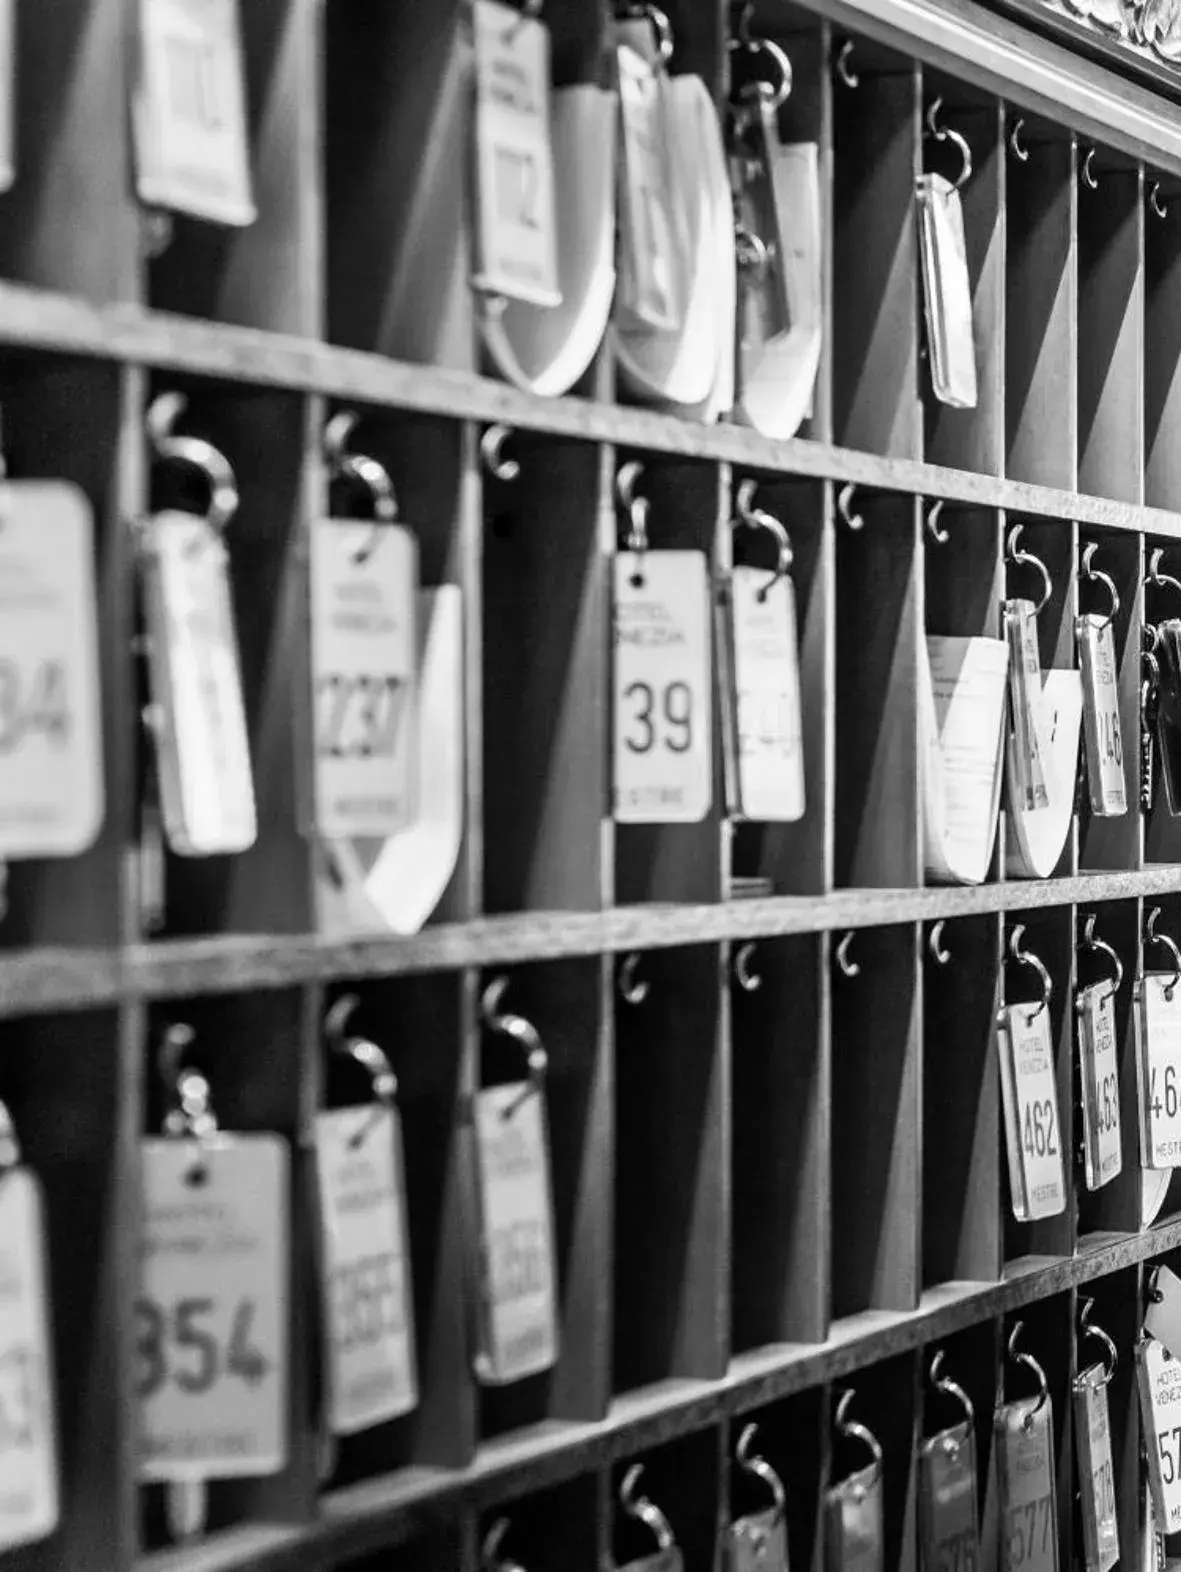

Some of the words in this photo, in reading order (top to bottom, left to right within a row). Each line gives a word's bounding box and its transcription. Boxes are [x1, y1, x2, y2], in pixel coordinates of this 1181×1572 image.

[1024, 1099, 1057, 1158] 462
[1097, 1072, 1118, 1135] 463
[1008, 1495, 1051, 1567] 577
